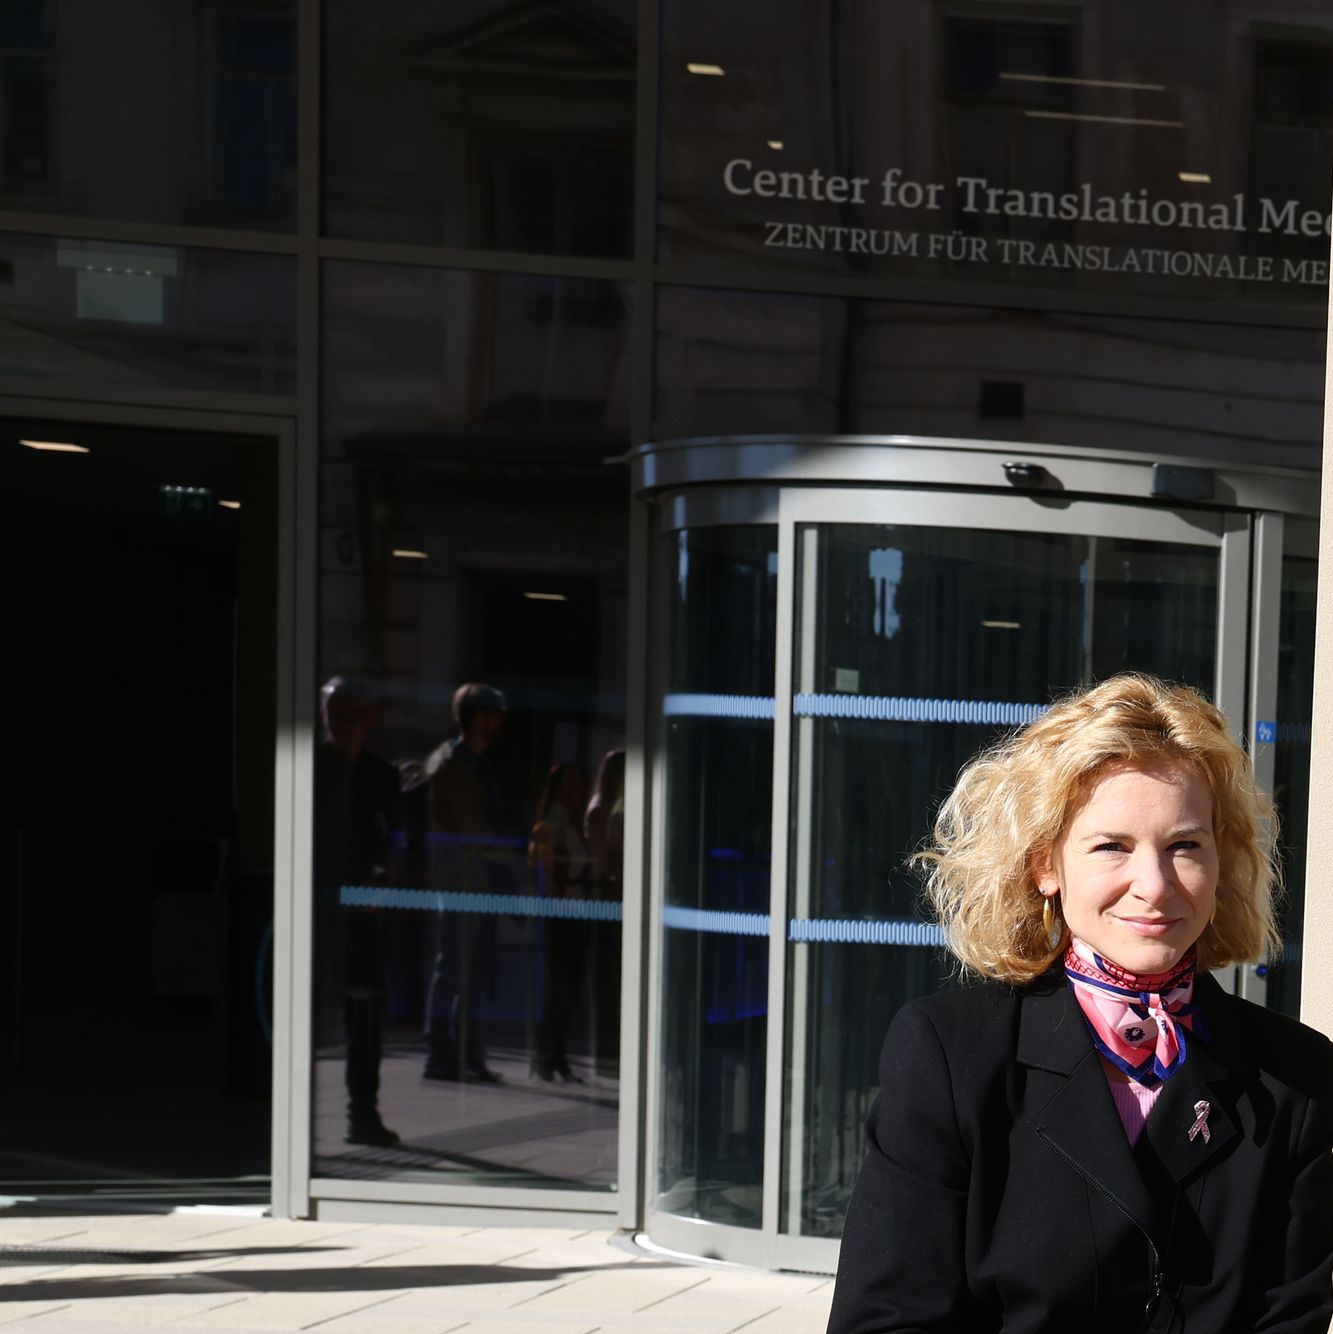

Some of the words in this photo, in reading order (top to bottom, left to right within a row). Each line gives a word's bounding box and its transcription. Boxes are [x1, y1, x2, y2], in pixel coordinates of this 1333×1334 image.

[723, 158, 869, 205] Center
[881, 168, 945, 210] for
[956, 175, 1247, 233] Translational
[764, 221, 920, 258] ZENTRUM
[928, 227, 988, 262] FÜR
[999, 237, 1274, 282] TRANSLATIONALE
